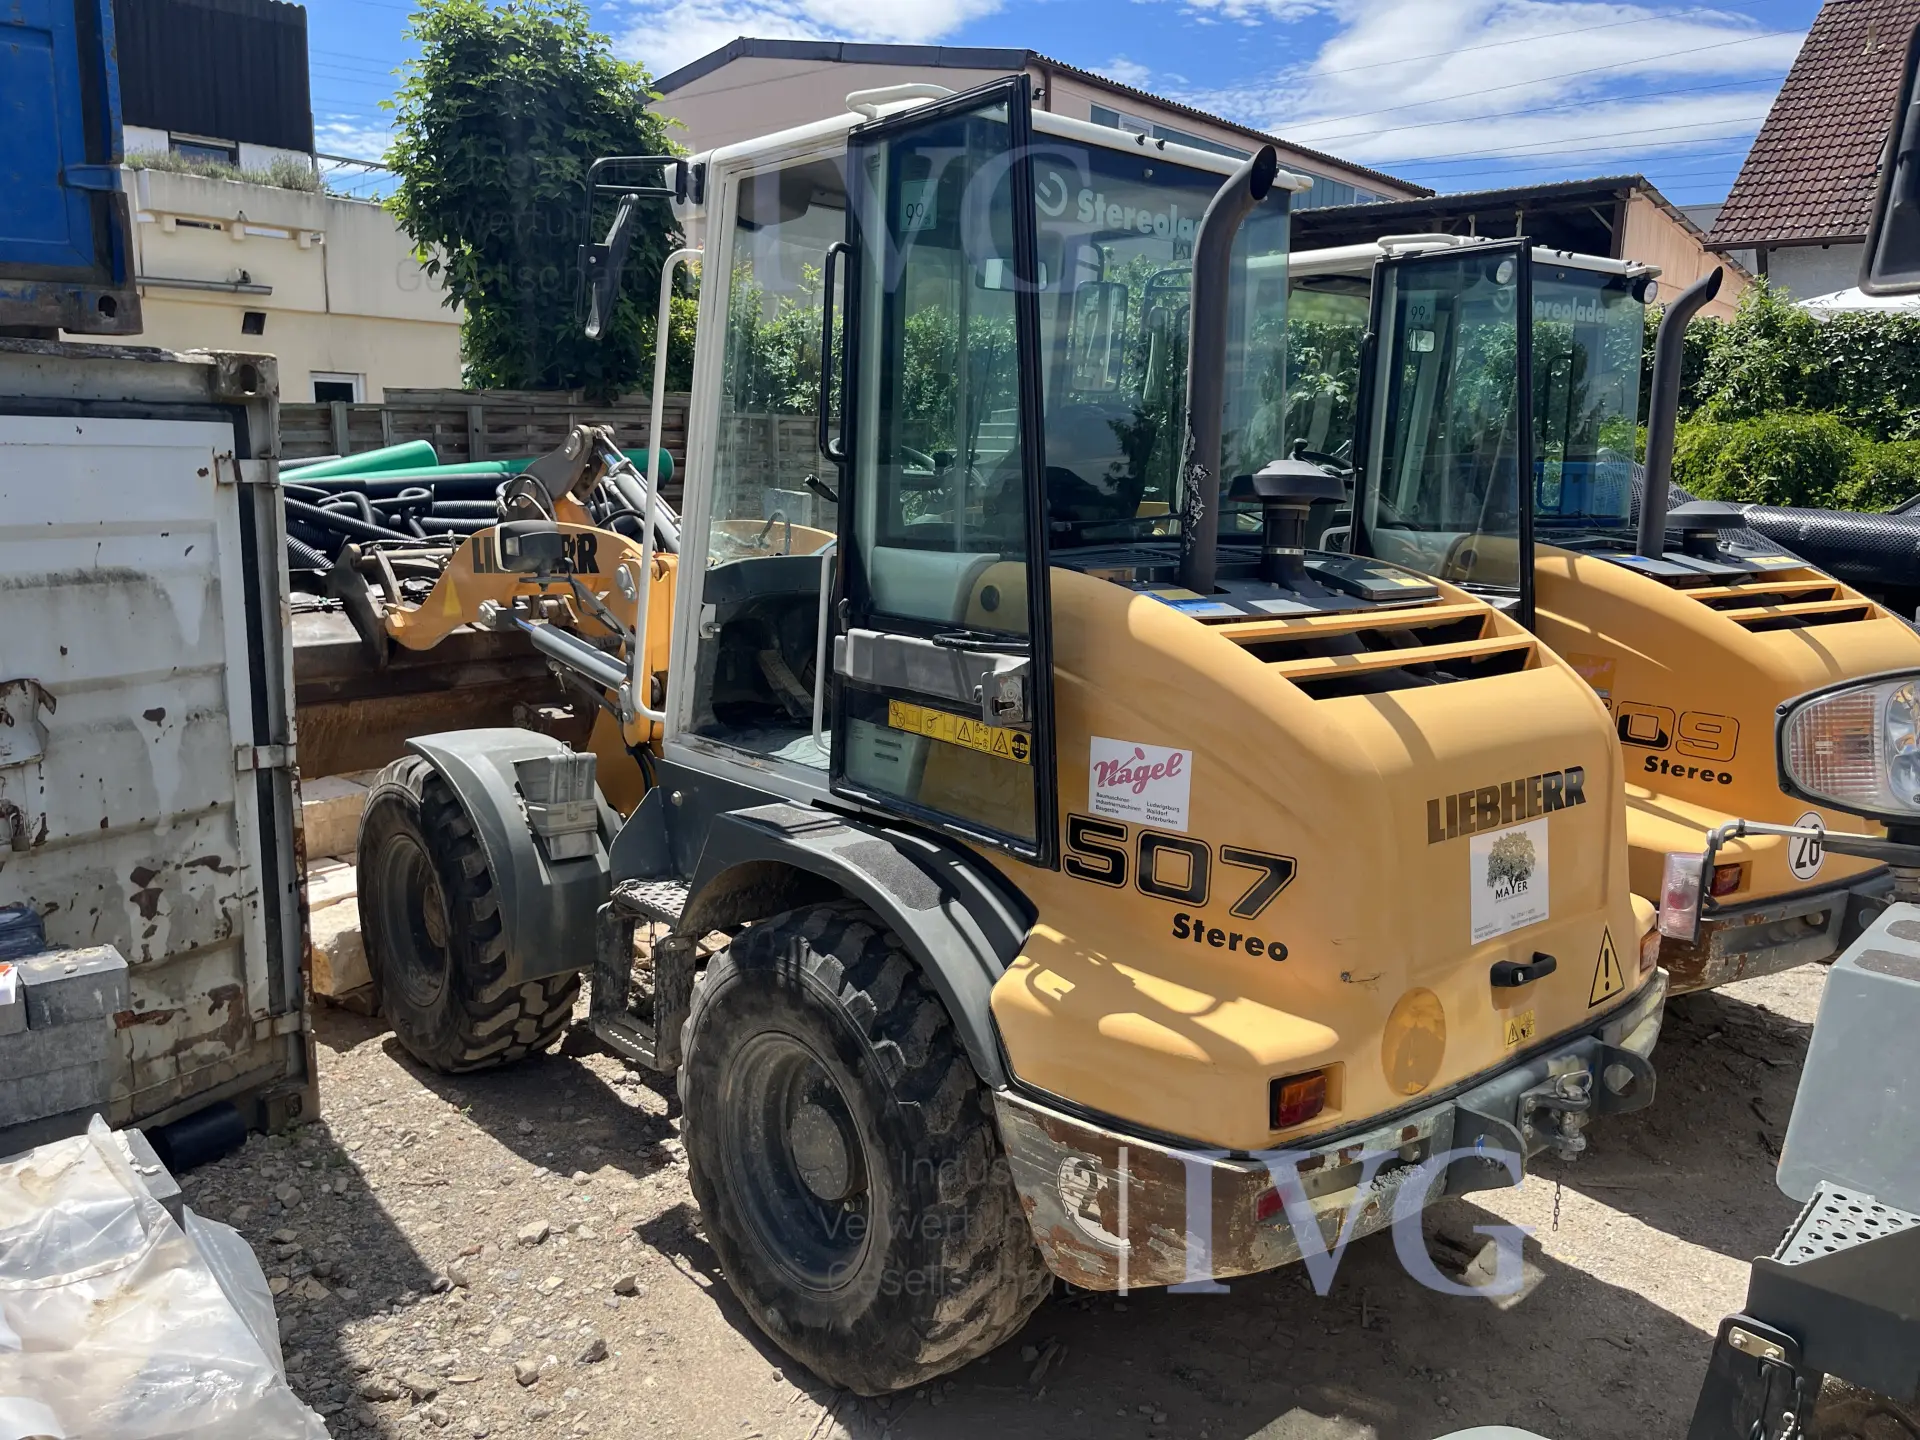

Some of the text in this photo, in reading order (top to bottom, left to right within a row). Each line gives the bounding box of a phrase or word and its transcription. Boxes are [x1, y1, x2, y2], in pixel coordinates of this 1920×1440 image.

[906, 203, 924, 226] 99
[1077, 188, 1200, 241] Stereola
[1411, 305, 1425, 321] 99
[472, 532, 600, 574] LIRR
[1602, 697, 1741, 763] 09
[1093, 751, 1184, 795] Nagel
[1644, 755, 1733, 785] Stereo
[1145, 814, 1178, 825] Osterburken
[1146, 801, 1180, 813] Ludwigsburg
[1426, 765, 1587, 845] LIEBHERR
[1063, 813, 1297, 921] 507
[1495, 879, 1529, 900] MAYER
[1172, 913, 1289, 962] Stereo
